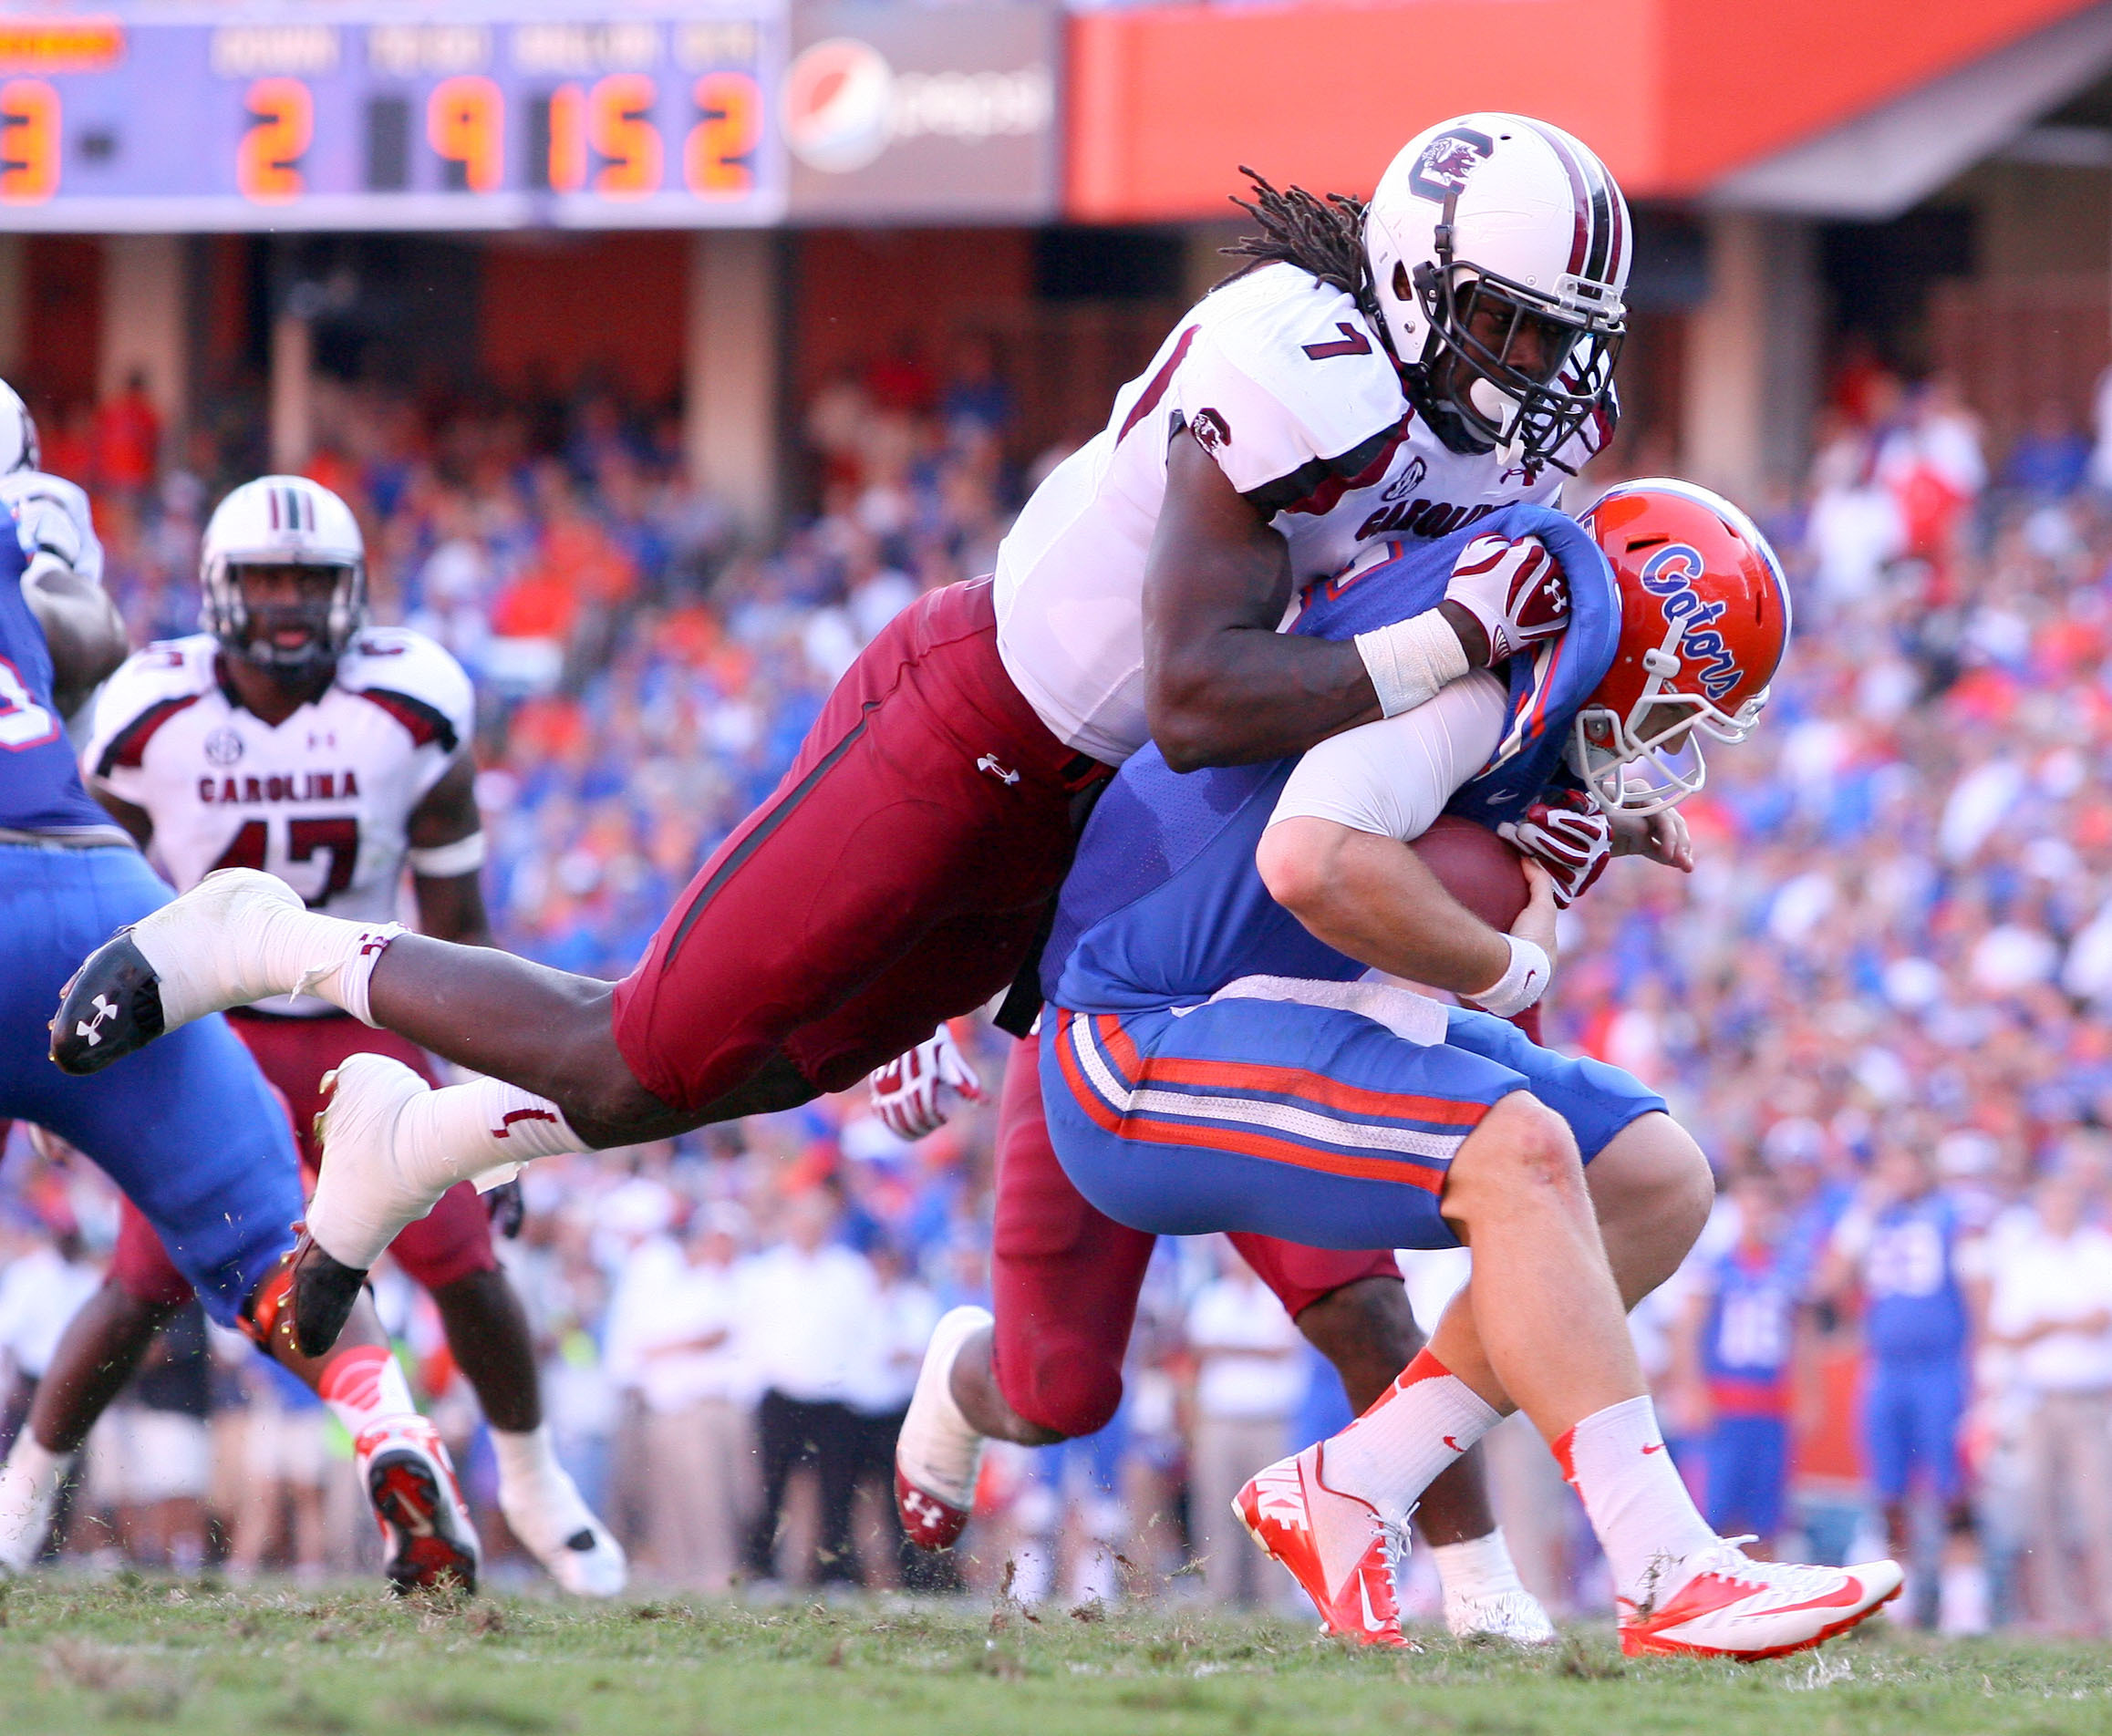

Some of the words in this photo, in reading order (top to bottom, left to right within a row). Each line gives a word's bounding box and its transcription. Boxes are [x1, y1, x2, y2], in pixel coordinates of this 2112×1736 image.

[237, 77, 314, 206] 2
[427, 75, 505, 196] 9
[1301, 322, 1372, 360] 7
[1640, 542, 1744, 700] Gators
[198, 770, 360, 804] CAROLINA
[204, 817, 360, 908] 47
